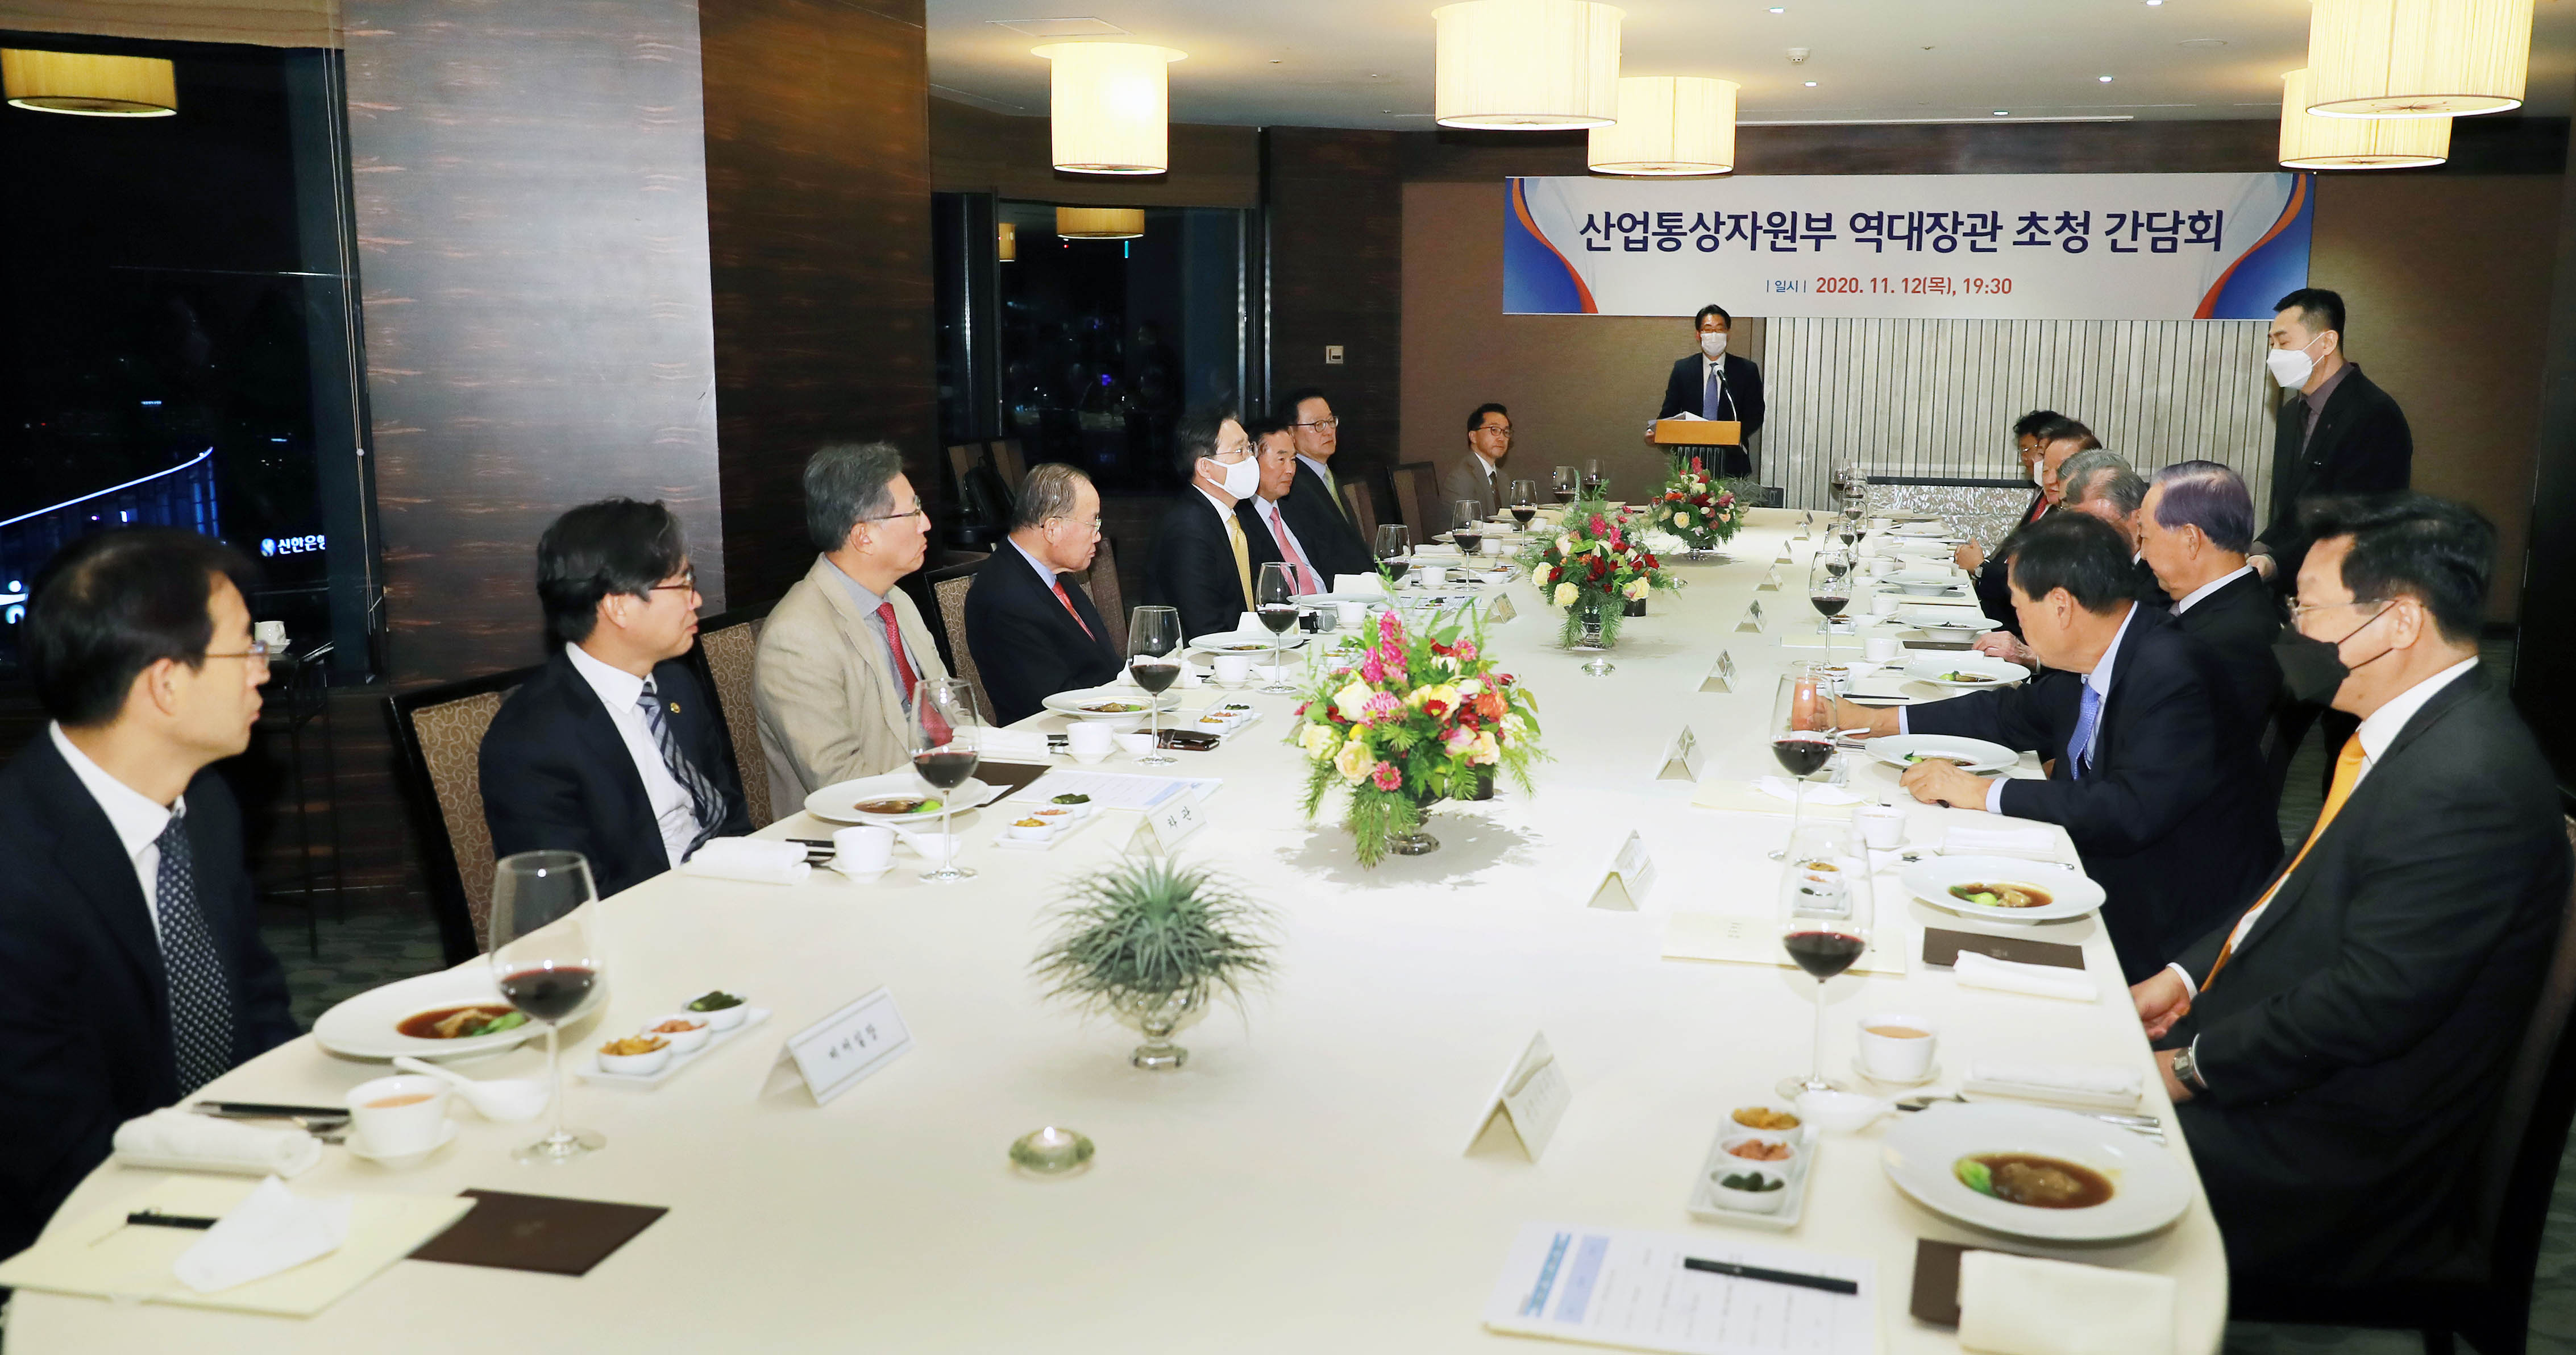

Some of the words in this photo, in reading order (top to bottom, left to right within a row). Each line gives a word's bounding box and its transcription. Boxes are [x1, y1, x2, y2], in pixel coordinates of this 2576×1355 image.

[1579, 211, 1837, 252] 산업통상자원부
[1849, 211, 2003, 253] 역대장관
[2013, 210, 2091, 254] 초청
[2104, 209, 2224, 253] 간담회
[1816, 277, 1863, 293] 2020.
[1870, 277, 1894, 293] 11.
[1901, 277, 1956, 296] 12(목),
[1963, 278, 2012, 294] 19:30
